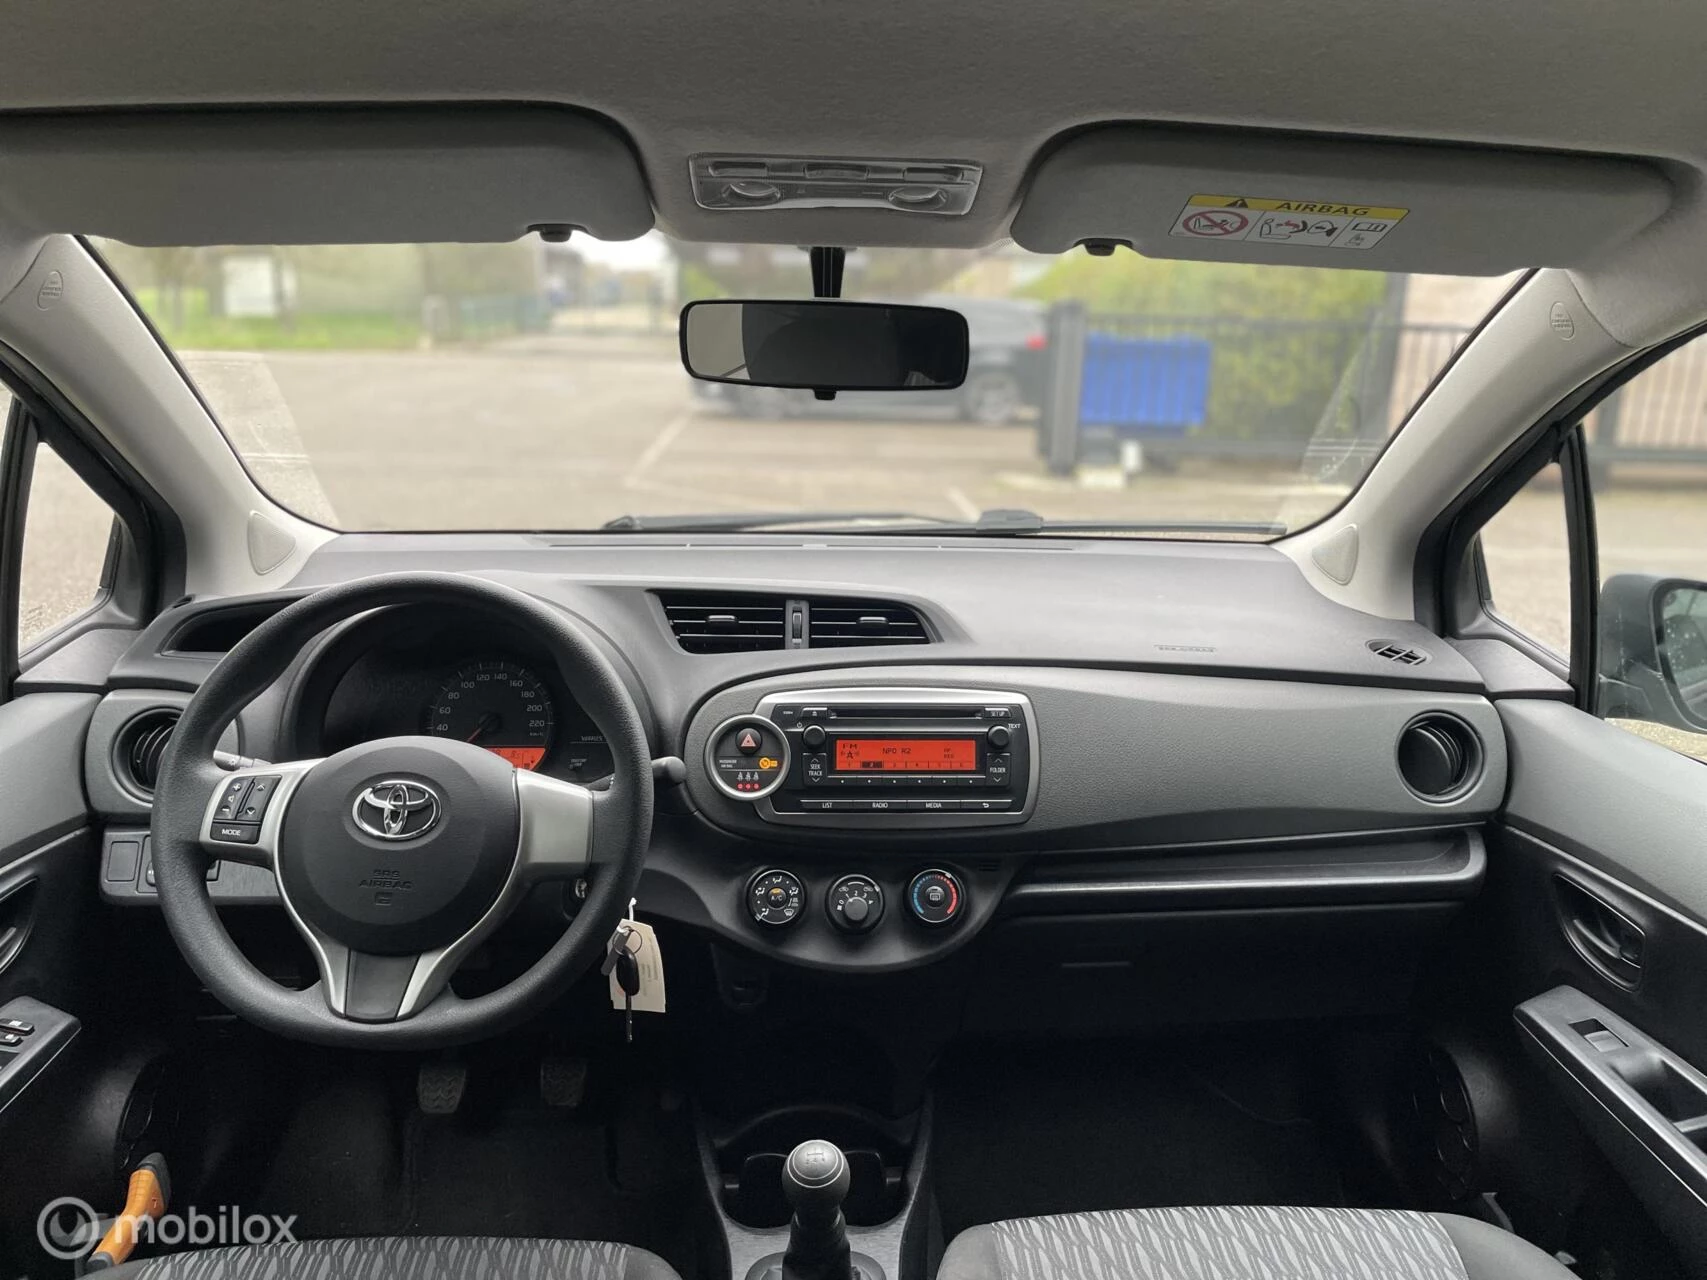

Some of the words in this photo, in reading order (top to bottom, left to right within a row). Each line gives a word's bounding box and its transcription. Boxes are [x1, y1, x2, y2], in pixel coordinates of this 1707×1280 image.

[1275, 201, 1370, 217] AIRBAG
[477, 673, 490, 681] 120
[494, 673, 508, 681] 140
[461, 681, 475, 689] 100
[510, 680, 523, 688] 160
[448, 692, 460, 700] 80
[439, 706, 451, 714] 60
[526, 704, 543, 712] 200
[436, 723, 448, 731] 40
[529, 719, 545, 727] 220
[222, 828, 241, 837] MODE
[359, 879, 413, 890] AIRBAG
